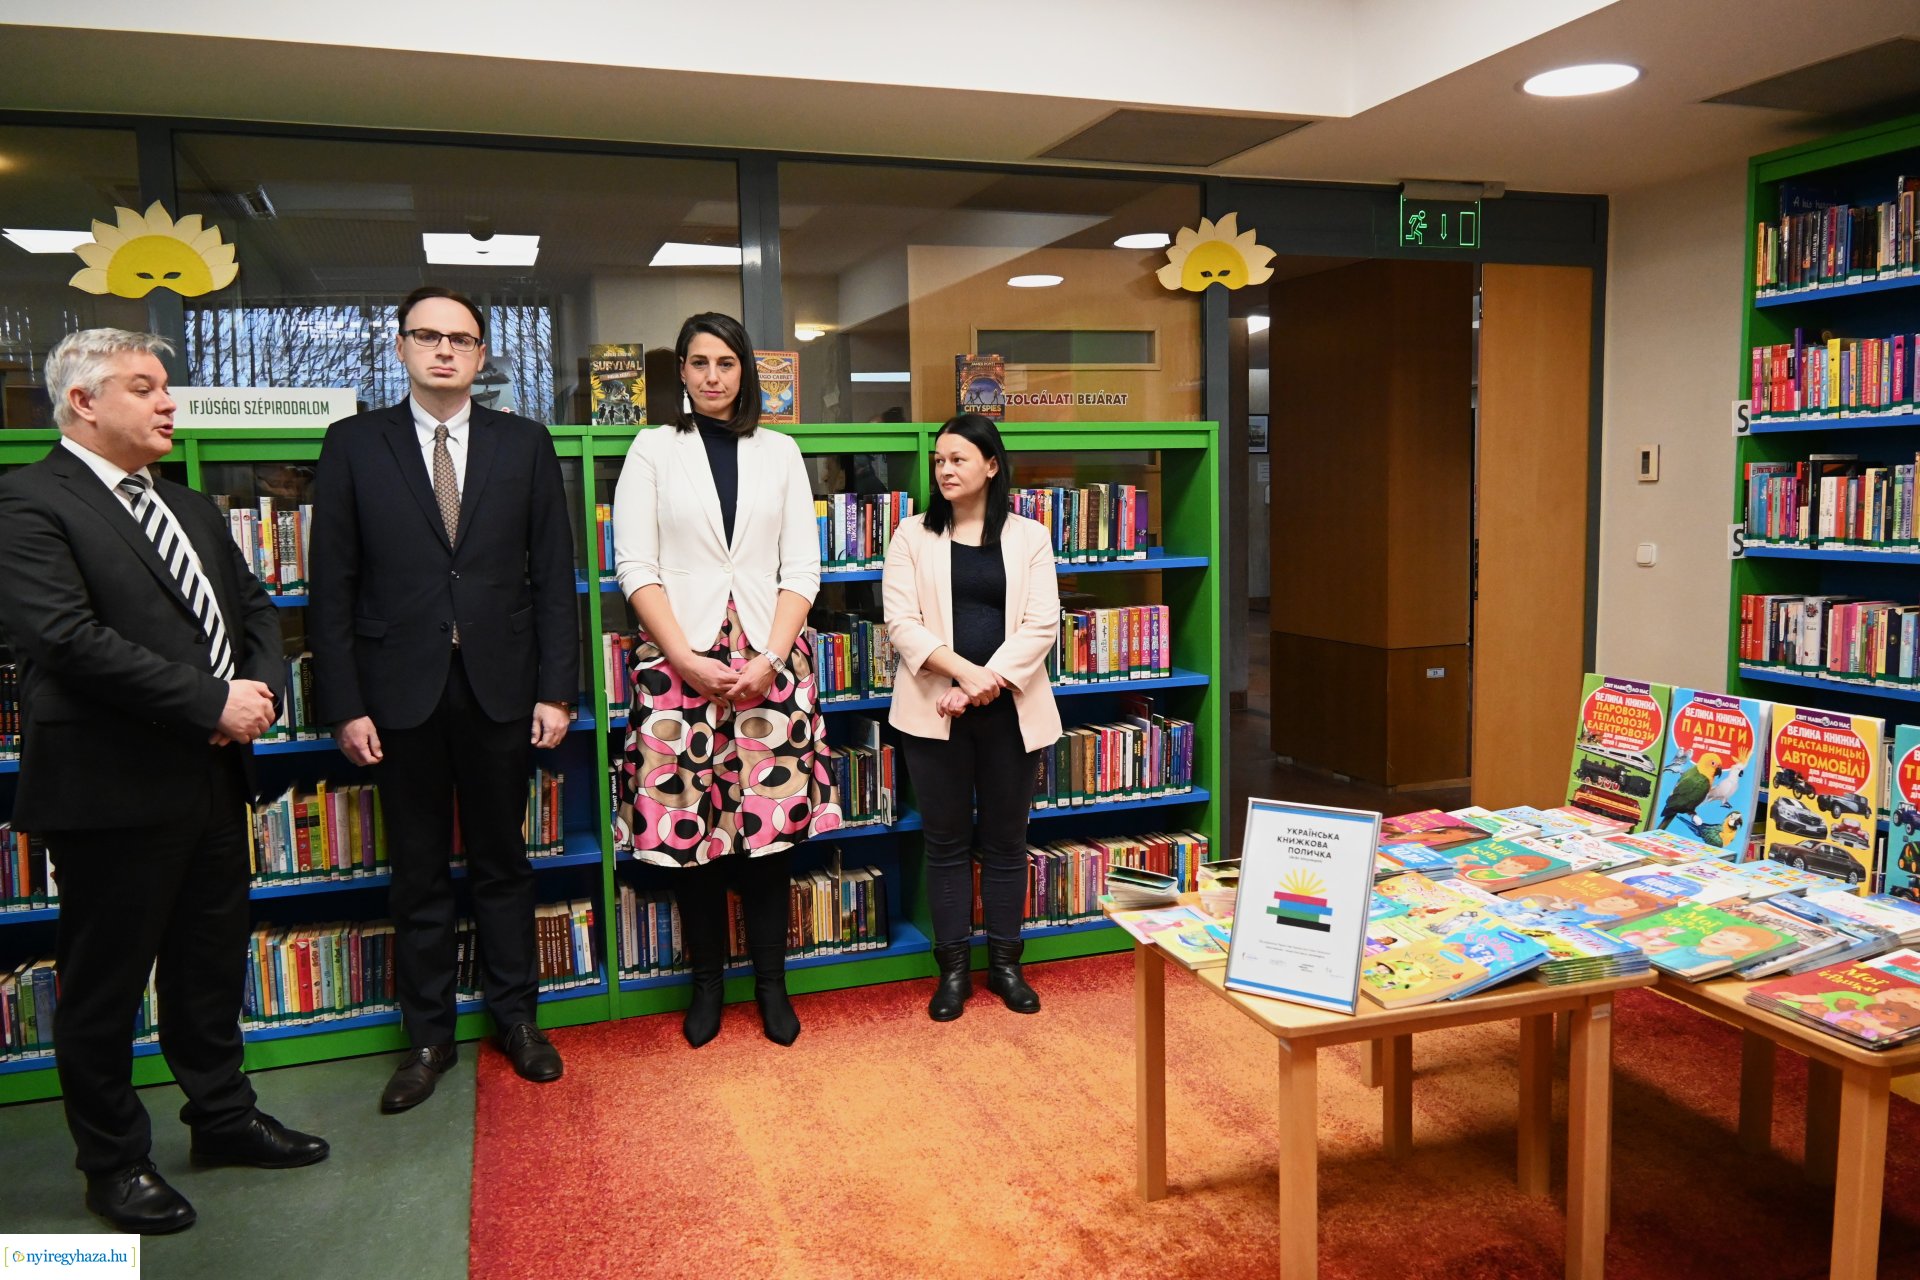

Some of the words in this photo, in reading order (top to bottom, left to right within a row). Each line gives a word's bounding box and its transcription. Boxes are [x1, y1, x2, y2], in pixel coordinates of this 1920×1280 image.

[592, 360, 643, 371] SURVIVAL
[189, 397, 241, 415] IFJÚSÁGI
[244, 398, 330, 415] SZÉPIRODALOM
[1005, 390, 1073, 405] ZOLGÁLATI
[1077, 389, 1128, 405] BEJÁRAT
[964, 404, 981, 412] CITY
[981, 404, 1002, 412] SPIES
[1738, 404, 1748, 432] S
[1732, 528, 1744, 557] S
[1595, 692, 1624, 705] ВЕЛИКА
[1624, 697, 1656, 711] КНИЖКА
[1596, 702, 1651, 720] ПАРОВОЗИ,
[1592, 711, 1652, 731] ТЕПЛОВОЗИ,
[1685, 706, 1714, 720] ВЕЛИКА
[1716, 712, 1747, 728] КНИЖКА
[1587, 720, 1655, 741] ЕЛЕКТРОВОЗИ
[1682, 718, 1748, 744] ПАПУГИ
[1787, 725, 1822, 740] ВЕЛИКА
[1824, 731, 1862, 748] КНИЖКА
[1780, 736, 1866, 760] ПРЕДСТАВНИЦЬКІ
[1782, 749, 1866, 778] АВТОМОБІЛІ
[882, 794, 889, 824] R
[1276, 836, 1328, 848] КНИЖКОВА
[1287, 828, 1340, 840] УКРАЇНСЬКА
[1288, 846, 1332, 859] ПОЛИЧКА
[1841, 968, 1890, 986] Мої
